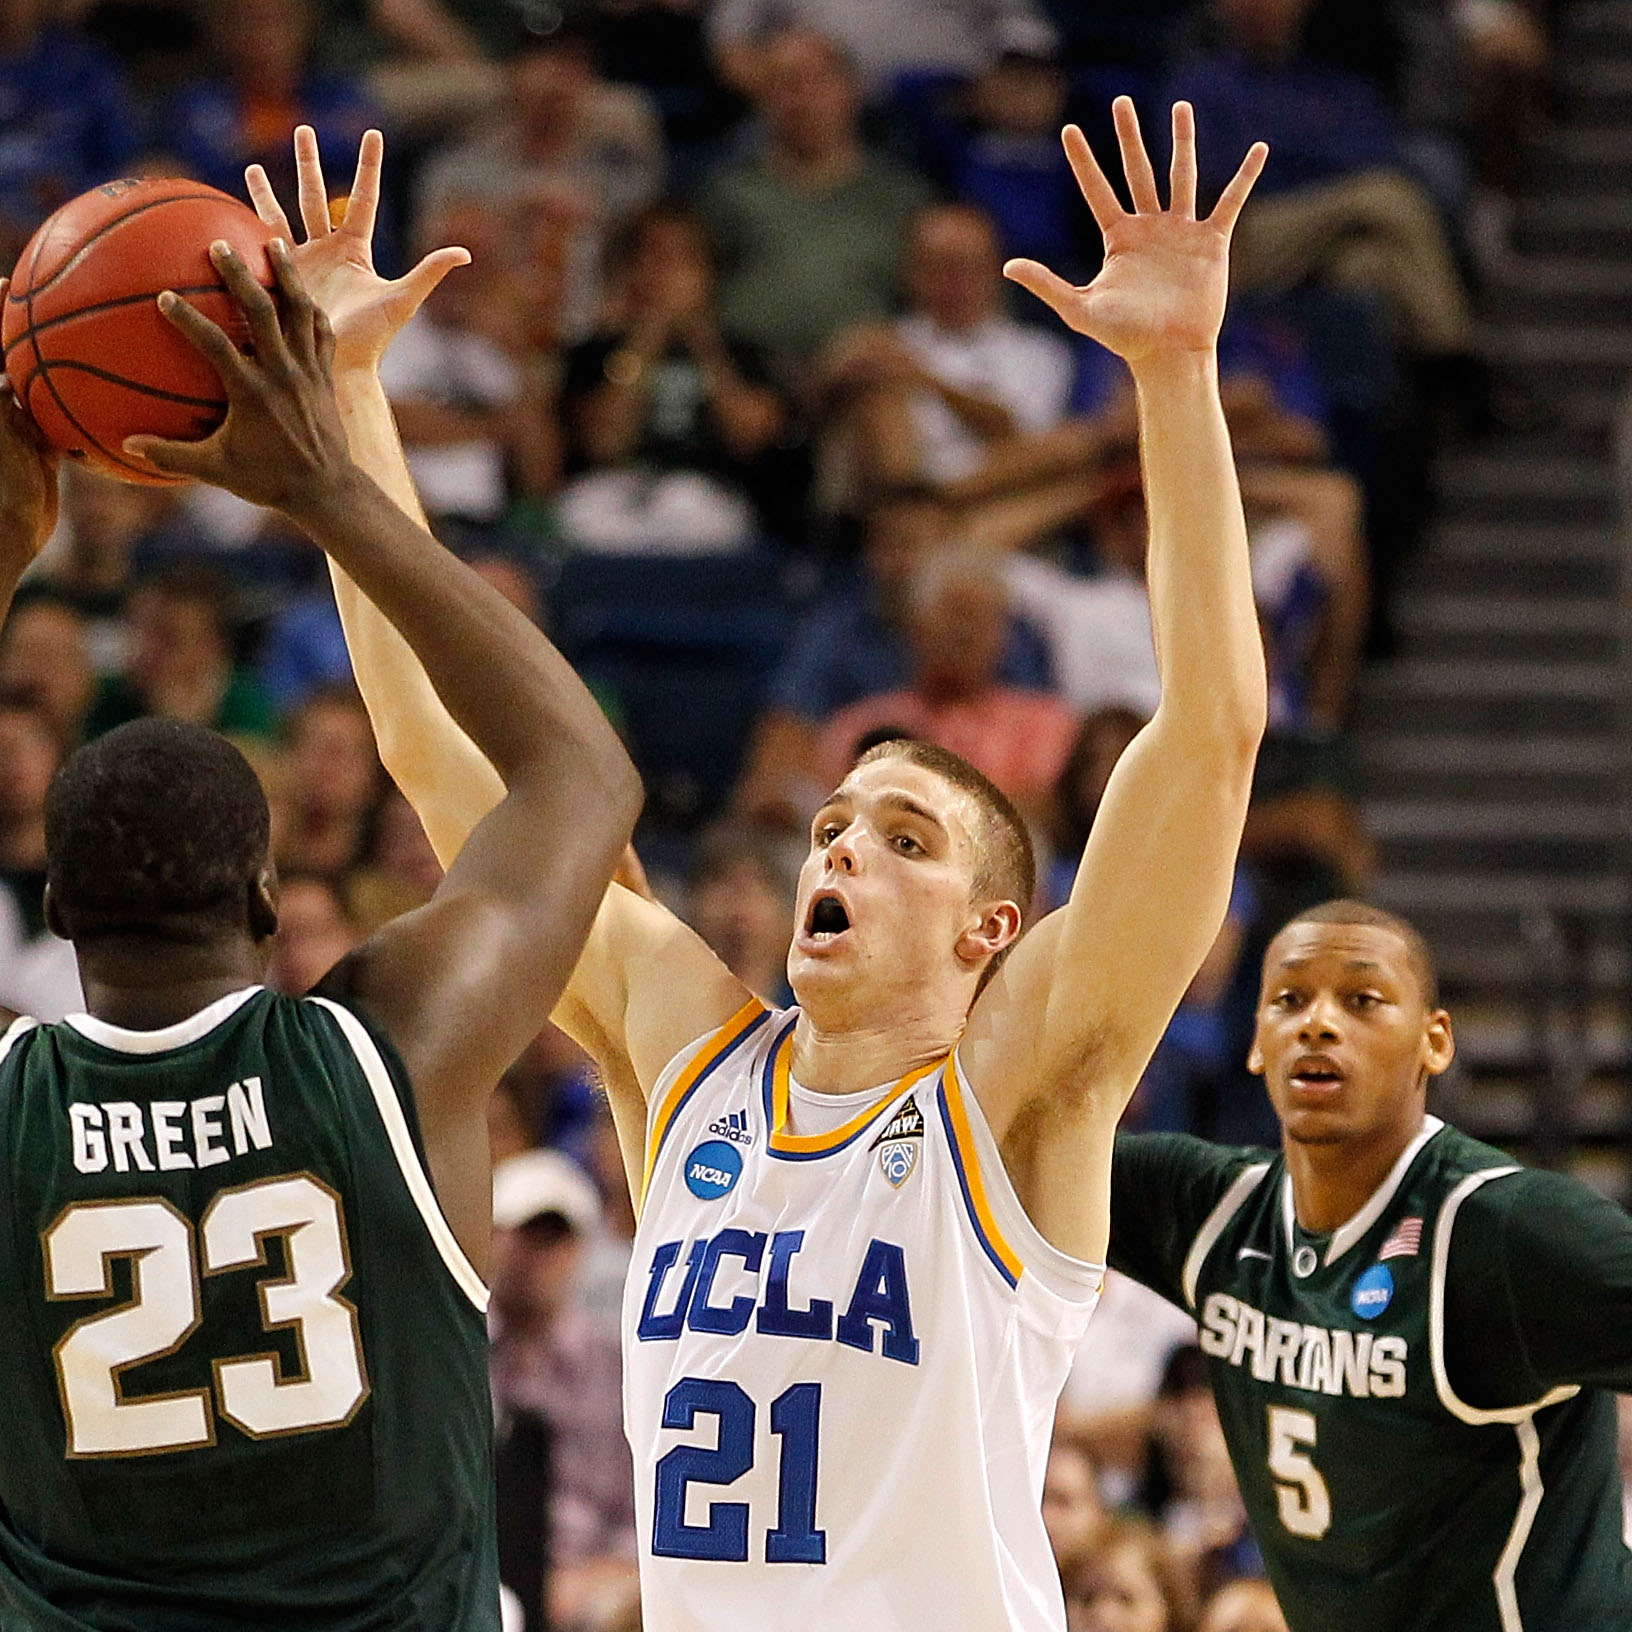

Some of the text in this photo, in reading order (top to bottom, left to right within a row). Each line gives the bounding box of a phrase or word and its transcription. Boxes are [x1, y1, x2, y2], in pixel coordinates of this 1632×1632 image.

[68, 1076, 273, 1174] GREEN
[689, 1163, 733, 1188] NCAA
[887, 1160, 908, 1178] 10
[40, 1170, 371, 1460] 23
[636, 1227, 920, 1366] UCLA
[651, 1376, 827, 1564] 21
[1266, 1403, 1334, 1541] 5
